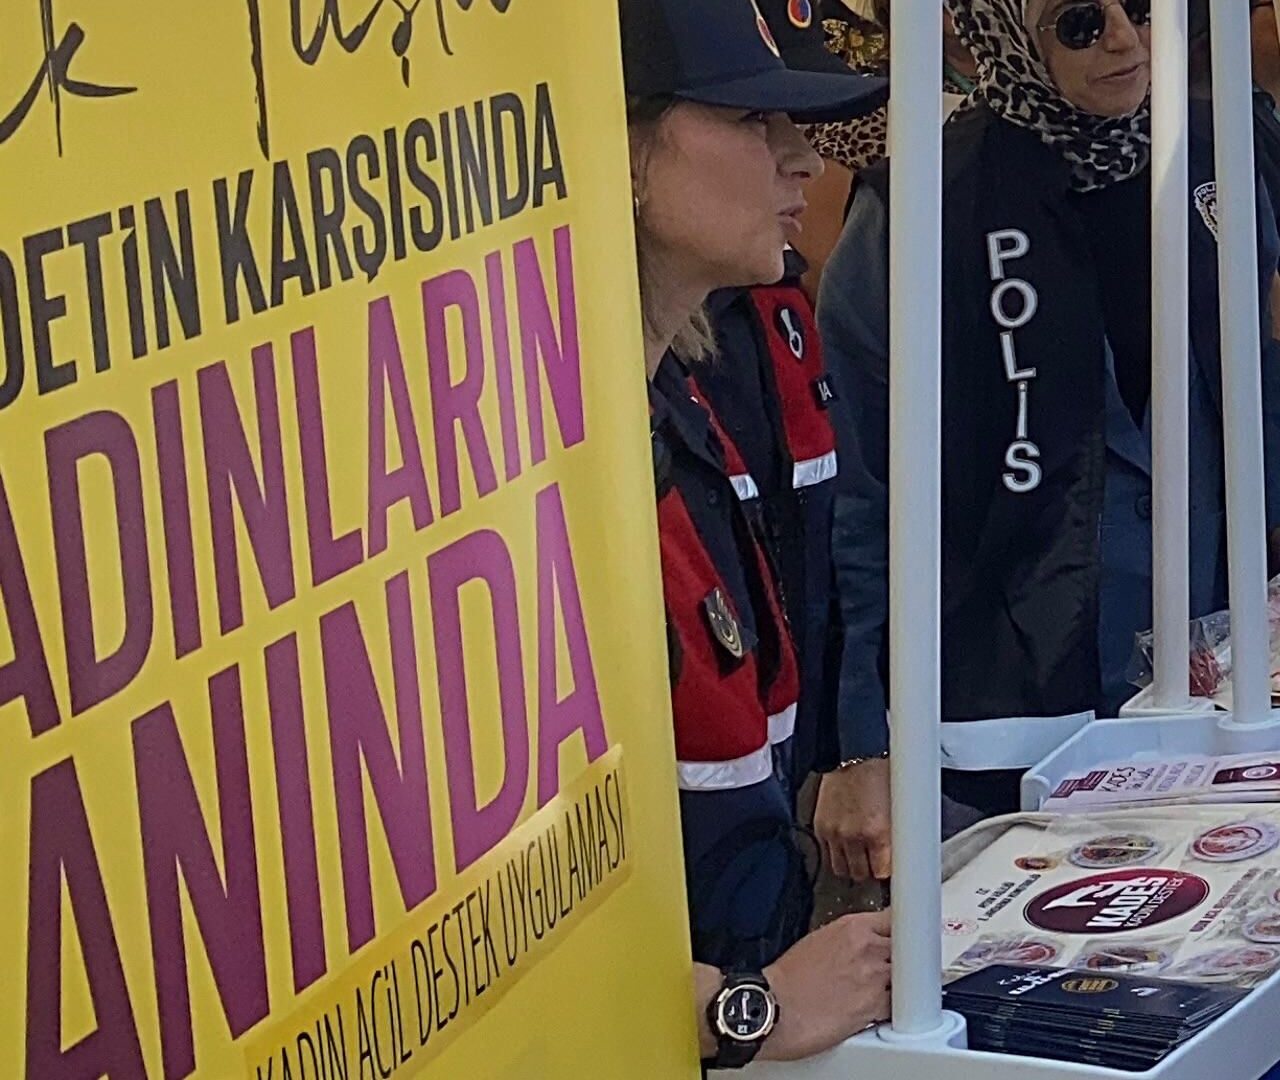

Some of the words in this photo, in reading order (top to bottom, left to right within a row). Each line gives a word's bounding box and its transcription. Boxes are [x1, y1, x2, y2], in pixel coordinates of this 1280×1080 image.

[213, 82, 568, 324] KARŞISINDA
[985, 227, 1044, 493] POLİS
[356, 959, 412, 1080] ACİL
[411, 879, 501, 1046] DESTEK
[497, 769, 626, 967] UYGULAMASI
[1086, 876, 1169, 928] KADES
